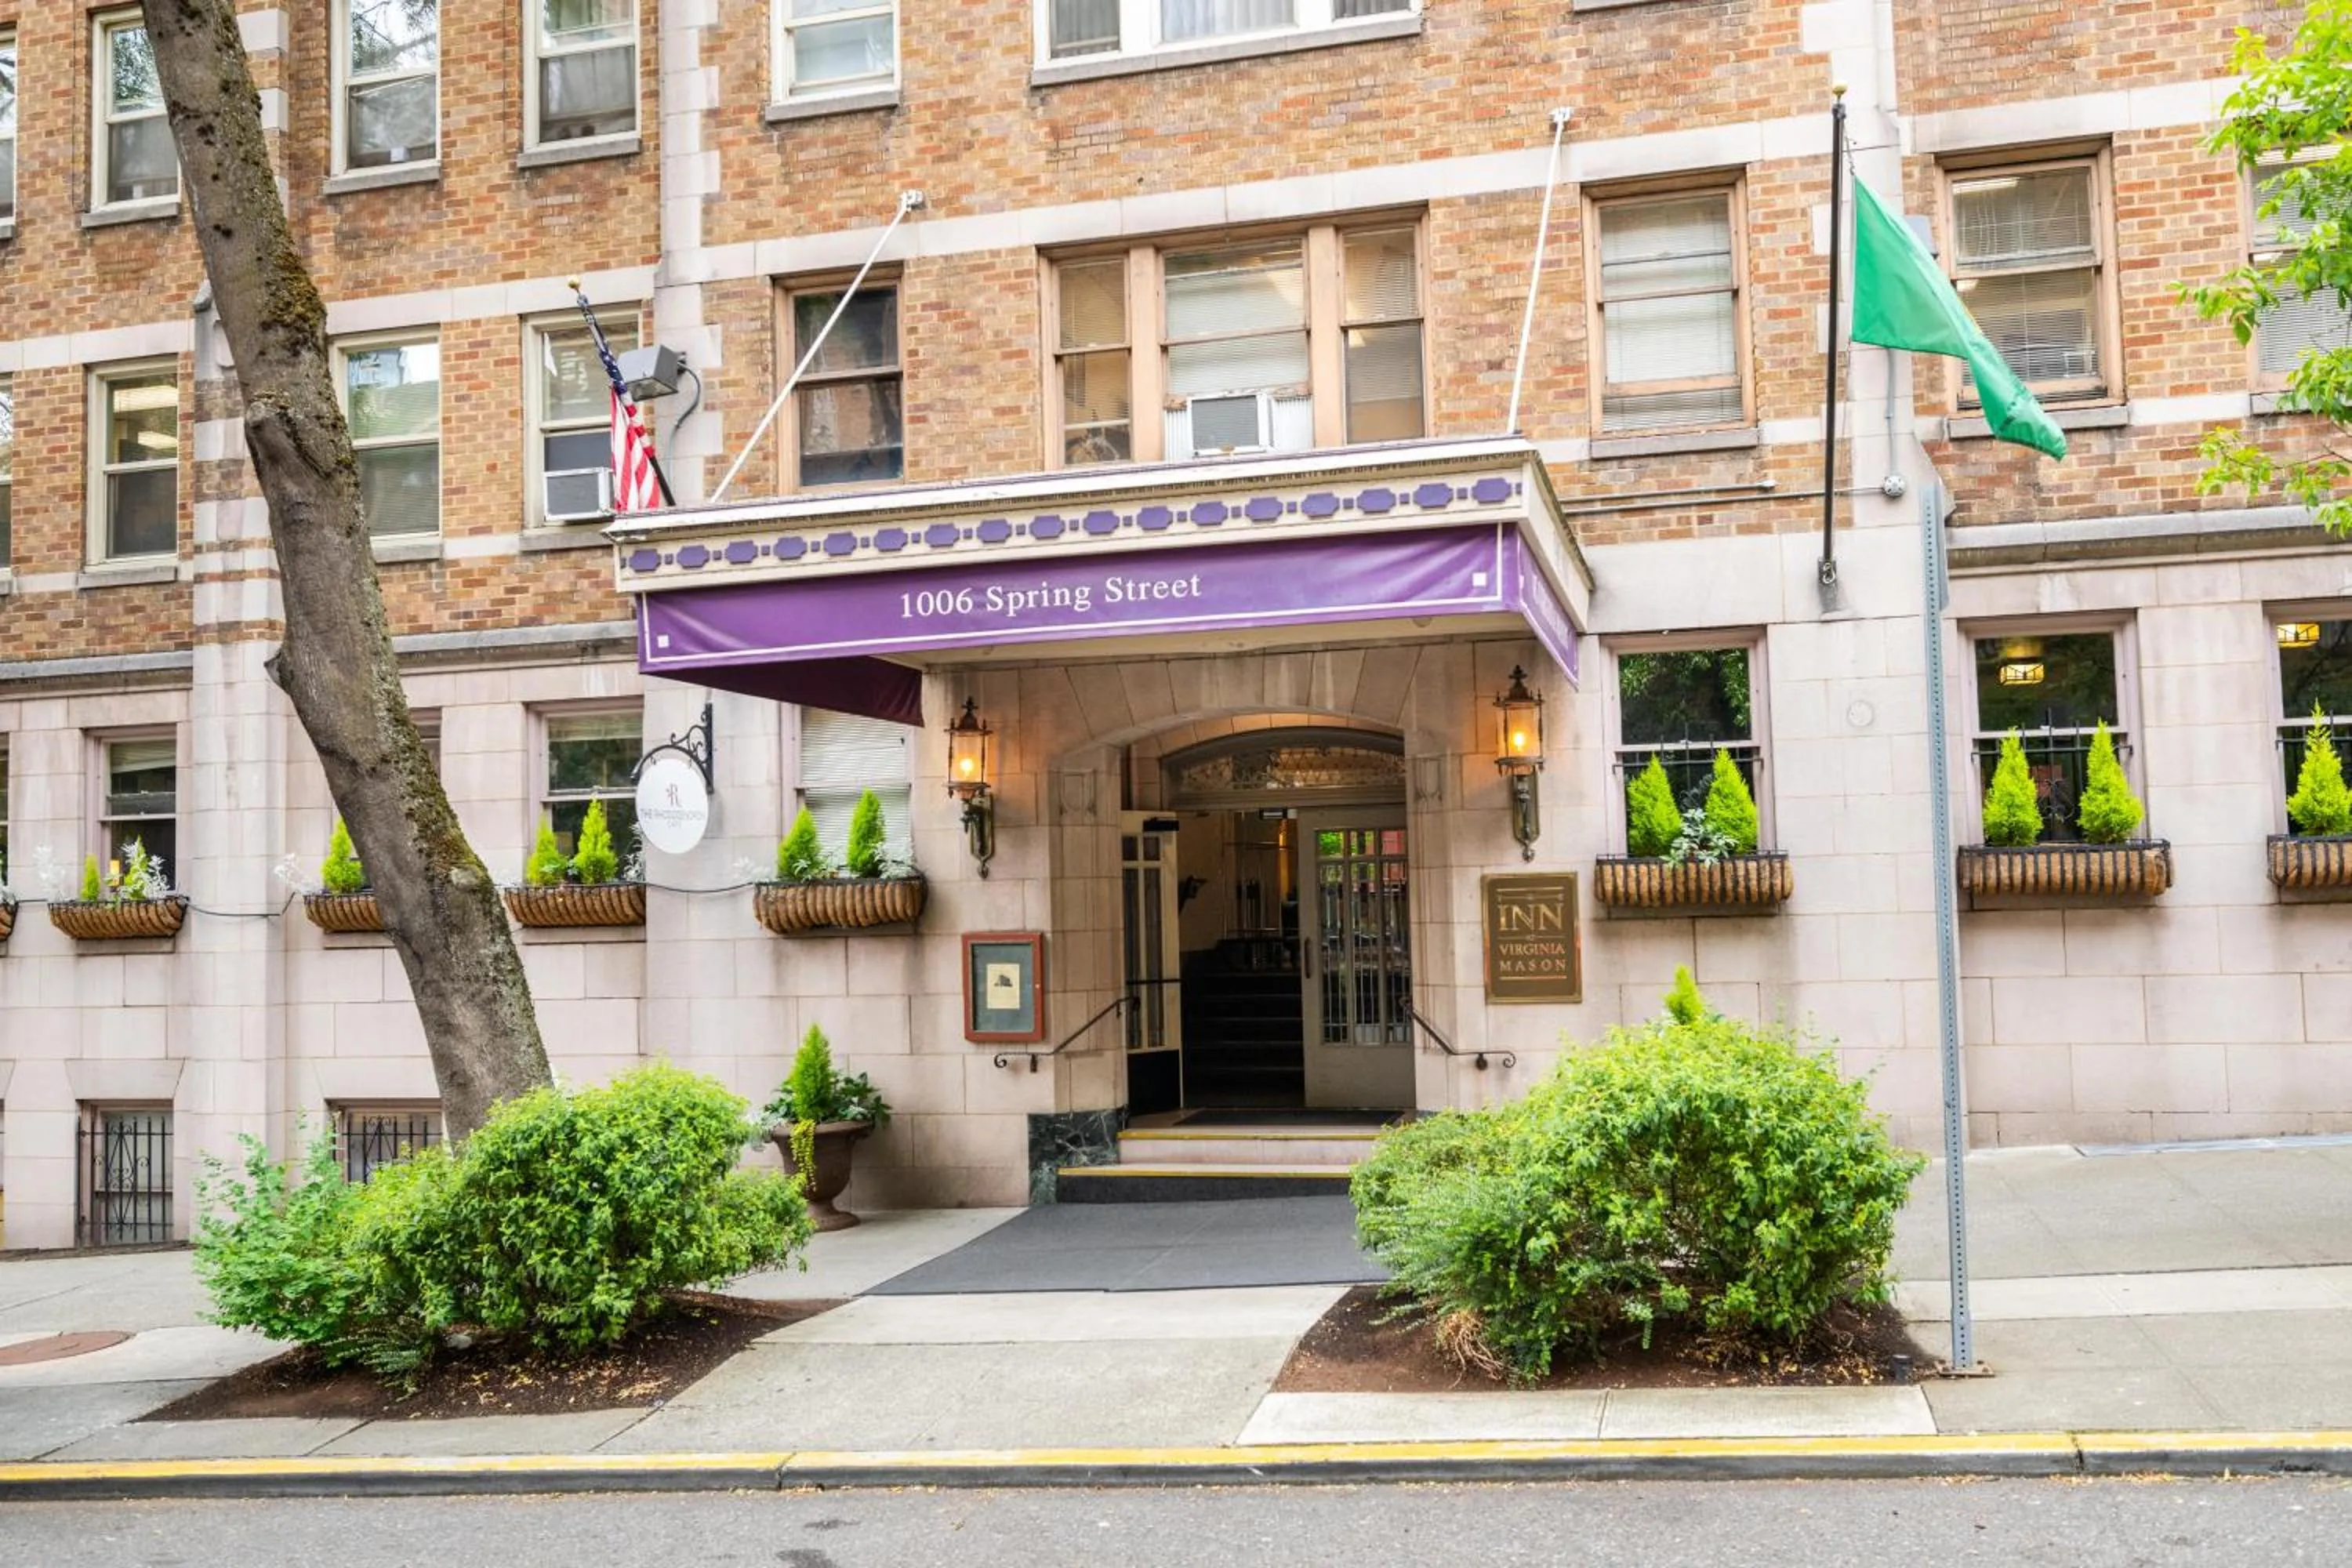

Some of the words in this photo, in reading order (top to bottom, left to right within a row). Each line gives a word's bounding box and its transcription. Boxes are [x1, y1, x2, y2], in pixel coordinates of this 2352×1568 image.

[901, 587, 974, 618] 1006
[986, 581, 1092, 617] Spring
[1105, 574, 1203, 603] Street
[1497, 902, 1564, 931] INN
[1499, 942, 1566, 956] VIRGINIA
[1500, 959, 1566, 972] MASON
